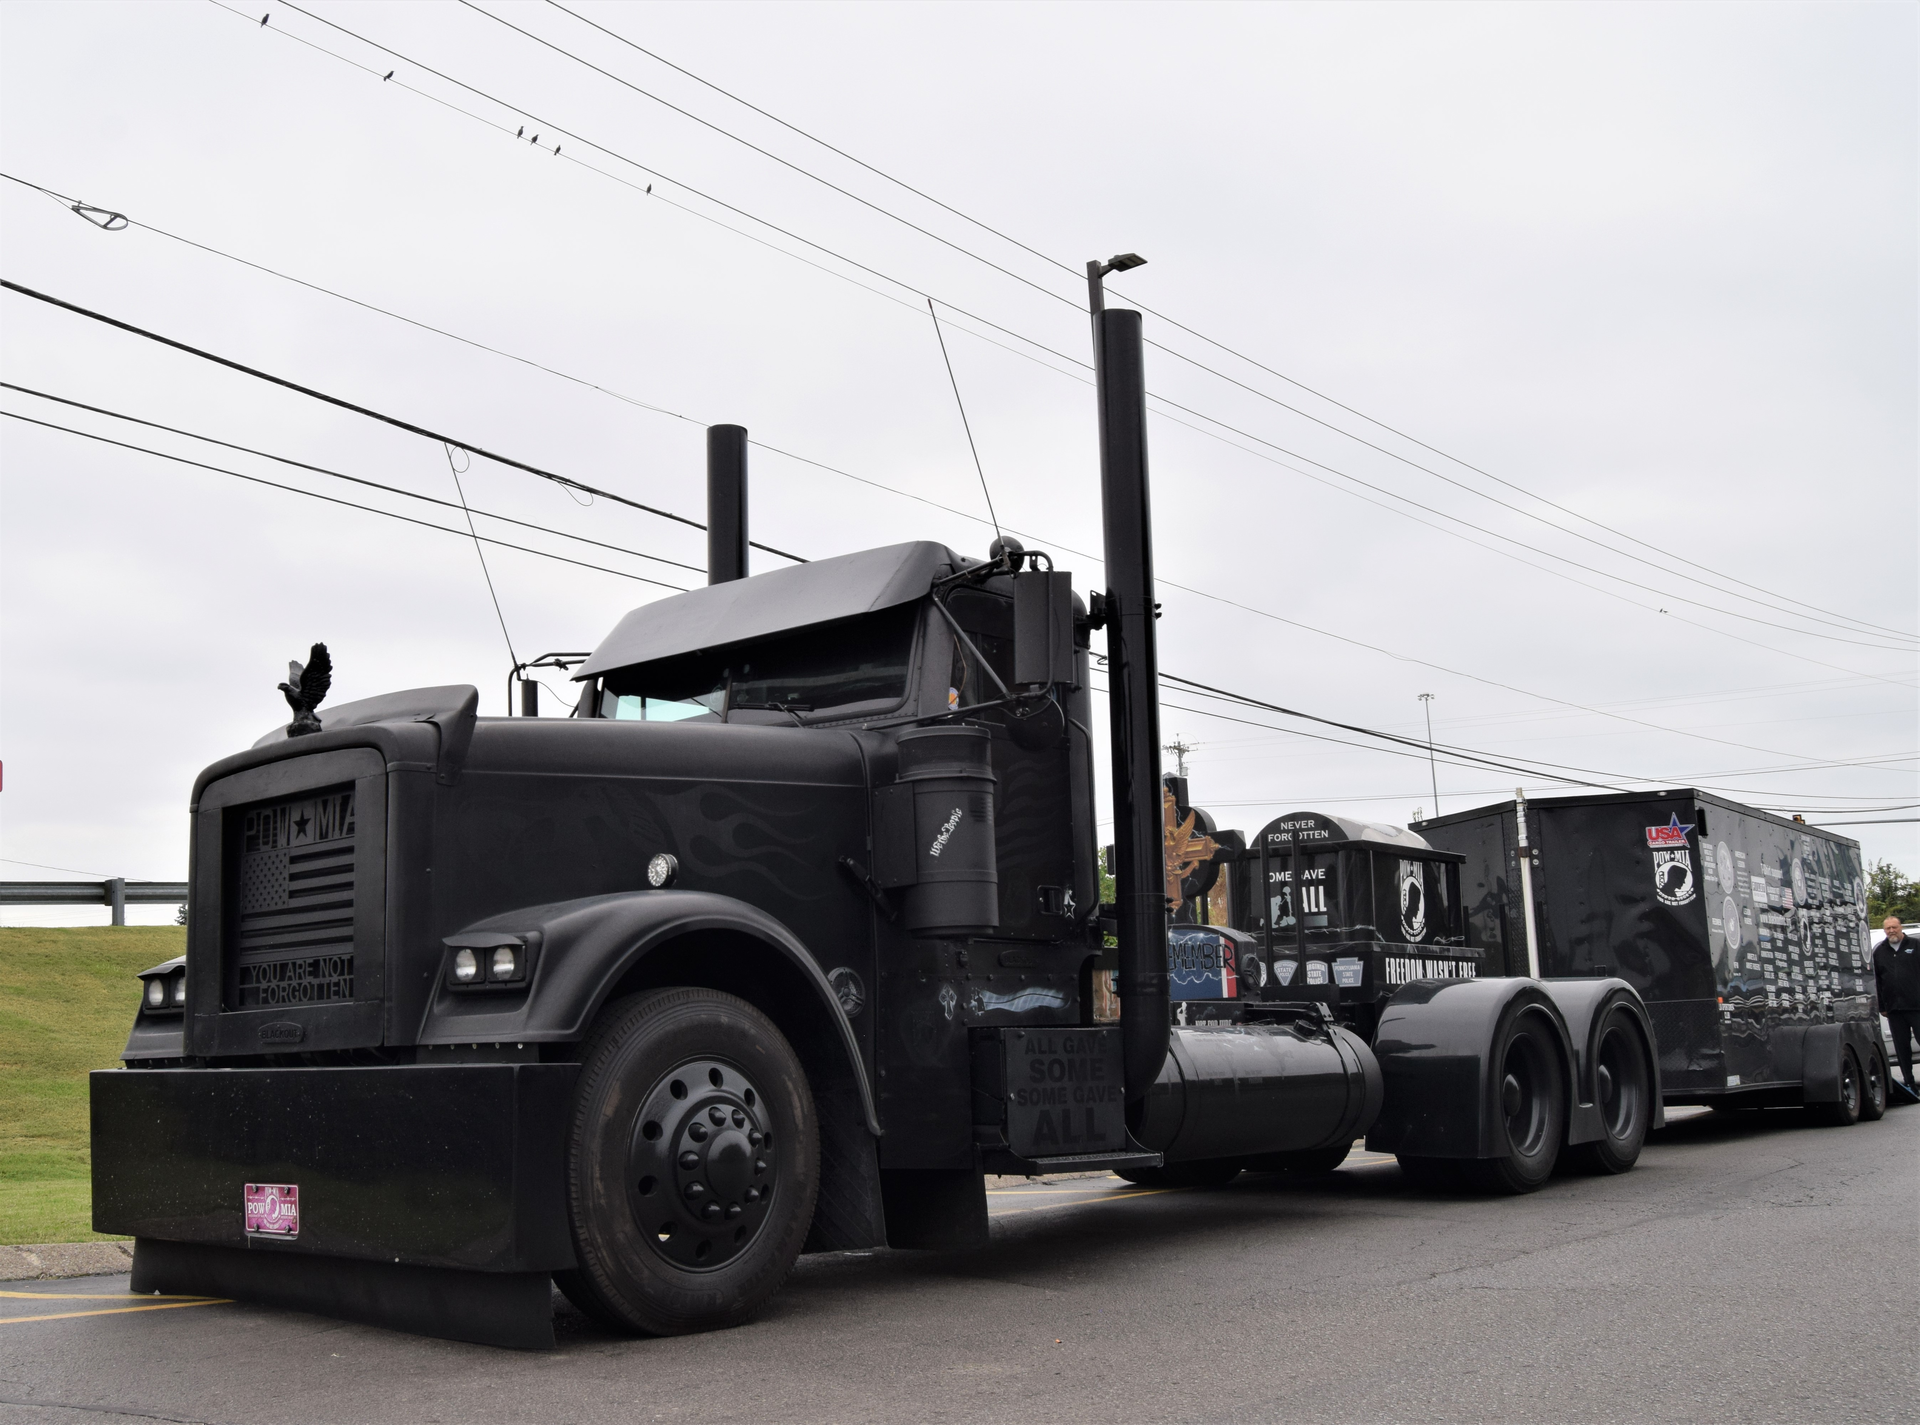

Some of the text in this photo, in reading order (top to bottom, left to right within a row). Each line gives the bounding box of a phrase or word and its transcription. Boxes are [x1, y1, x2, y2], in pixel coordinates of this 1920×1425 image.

[244, 806, 291, 852] POW
[1280, 820, 1315, 830] NEVER
[1647, 826, 1683, 840] USA
[1652, 851, 1671, 873] POW
[1674, 850, 1692, 871] MIA
[1269, 868, 1326, 883] OME AVE
[1168, 942, 1236, 973] EMEMBER
[1307, 963, 1325, 971] IRGINIA
[250, 955, 352, 985] YOU ARE NOT
[1385, 957, 1477, 985] FREEDOM WASN'T FREE
[260, 977, 350, 1004] FORGOTTEN
[261, 1029, 297, 1039] BLACKOUT
[1025, 1036, 1107, 1055] ALL GAVE
[1029, 1058, 1105, 1084] SOME
[1017, 1085, 1117, 1107] SOME GAVE
[1032, 1107, 1107, 1145] ALL
[247, 1202, 297, 1216] POW MIA
